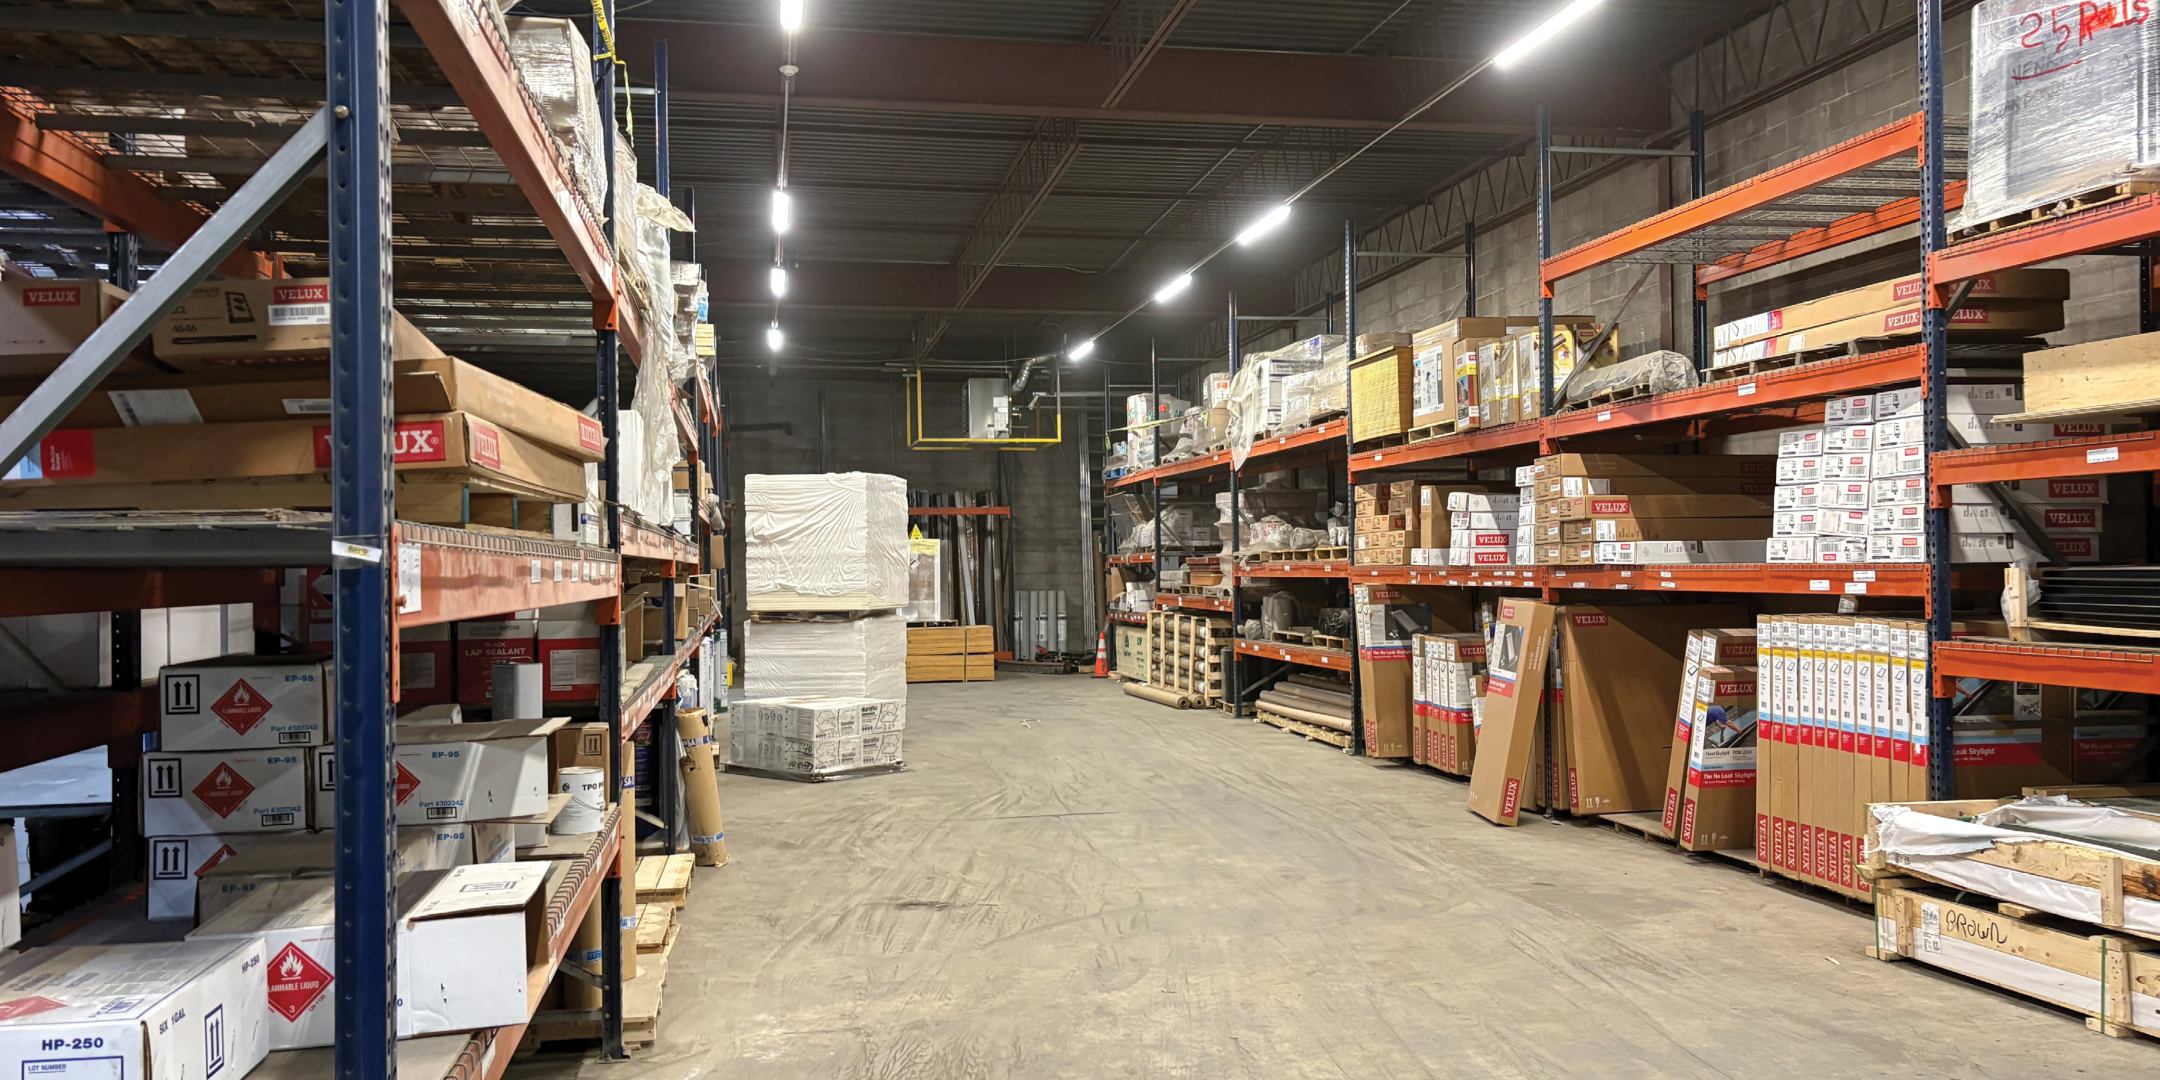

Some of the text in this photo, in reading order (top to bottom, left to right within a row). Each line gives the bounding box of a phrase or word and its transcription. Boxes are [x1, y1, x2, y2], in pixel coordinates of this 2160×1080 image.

[2020, 5, 2071, 53] 25
[27, 291, 76, 302] VELUX
[278, 289, 324, 300] VELUX
[1887, 312, 1918, 327] VELUX
[1952, 308, 1985, 321] ELUX
[475, 430, 498, 461] VELUX
[2053, 483, 2095, 494] VELUX
[1594, 502, 1627, 512] VELUX
[2049, 513, 2092, 524] VELUX
[1479, 536, 1506, 544] VELUX
[1477, 554, 1506, 562] VELUX
[1575, 615, 1605, 624] VELUX
[485, 648, 526, 656] SEALANT
[1720, 684, 1753, 694] VELUX
[1968, 747, 1995, 756] Skylight
[582, 783, 597, 791] TPO
[1504, 781, 1518, 814] VELUX
[1665, 793, 1676, 826] VELUX
[1683, 803, 1693, 840] VELUX
[437, 832, 465, 840] EP-95
[1774, 821, 1782, 863] VELUX
[1787, 825, 1795, 867] VELUX
[1802, 829, 1810, 871] VELUX
[1828, 835, 1836, 880] VELUX
[1843, 839, 1851, 884] VELUX
[222, 884, 256, 893] EP-95
[242, 954, 260, 974] HP-250
[300, 980, 320, 990] LIQUID
[289, 1005, 295, 1013] 3
[159, 1022, 169, 1035] SIX
[42, 1037, 104, 1051] HP-250
[41, 1063, 67, 1071] NUMBER
